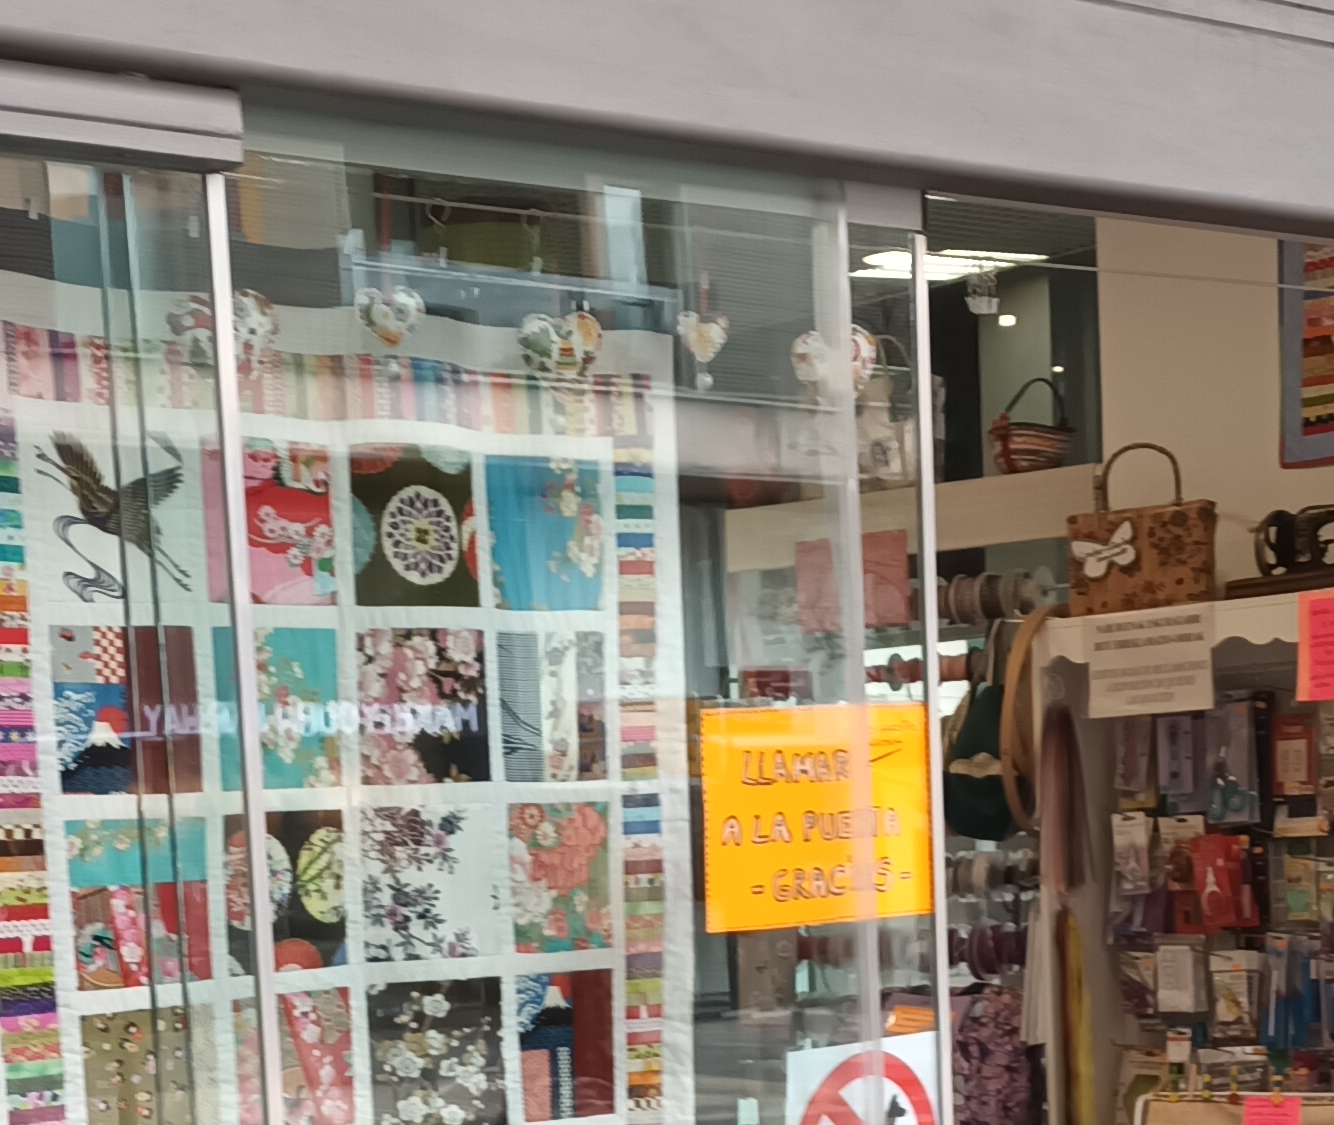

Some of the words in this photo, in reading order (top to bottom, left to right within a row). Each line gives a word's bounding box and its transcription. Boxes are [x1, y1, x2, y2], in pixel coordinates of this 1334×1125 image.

[742, 749, 850, 786] LLAMAR
[720, 815, 743, 846] A
[751, 811, 793, 844] LA
[802, 806, 902, 842] PUETA
